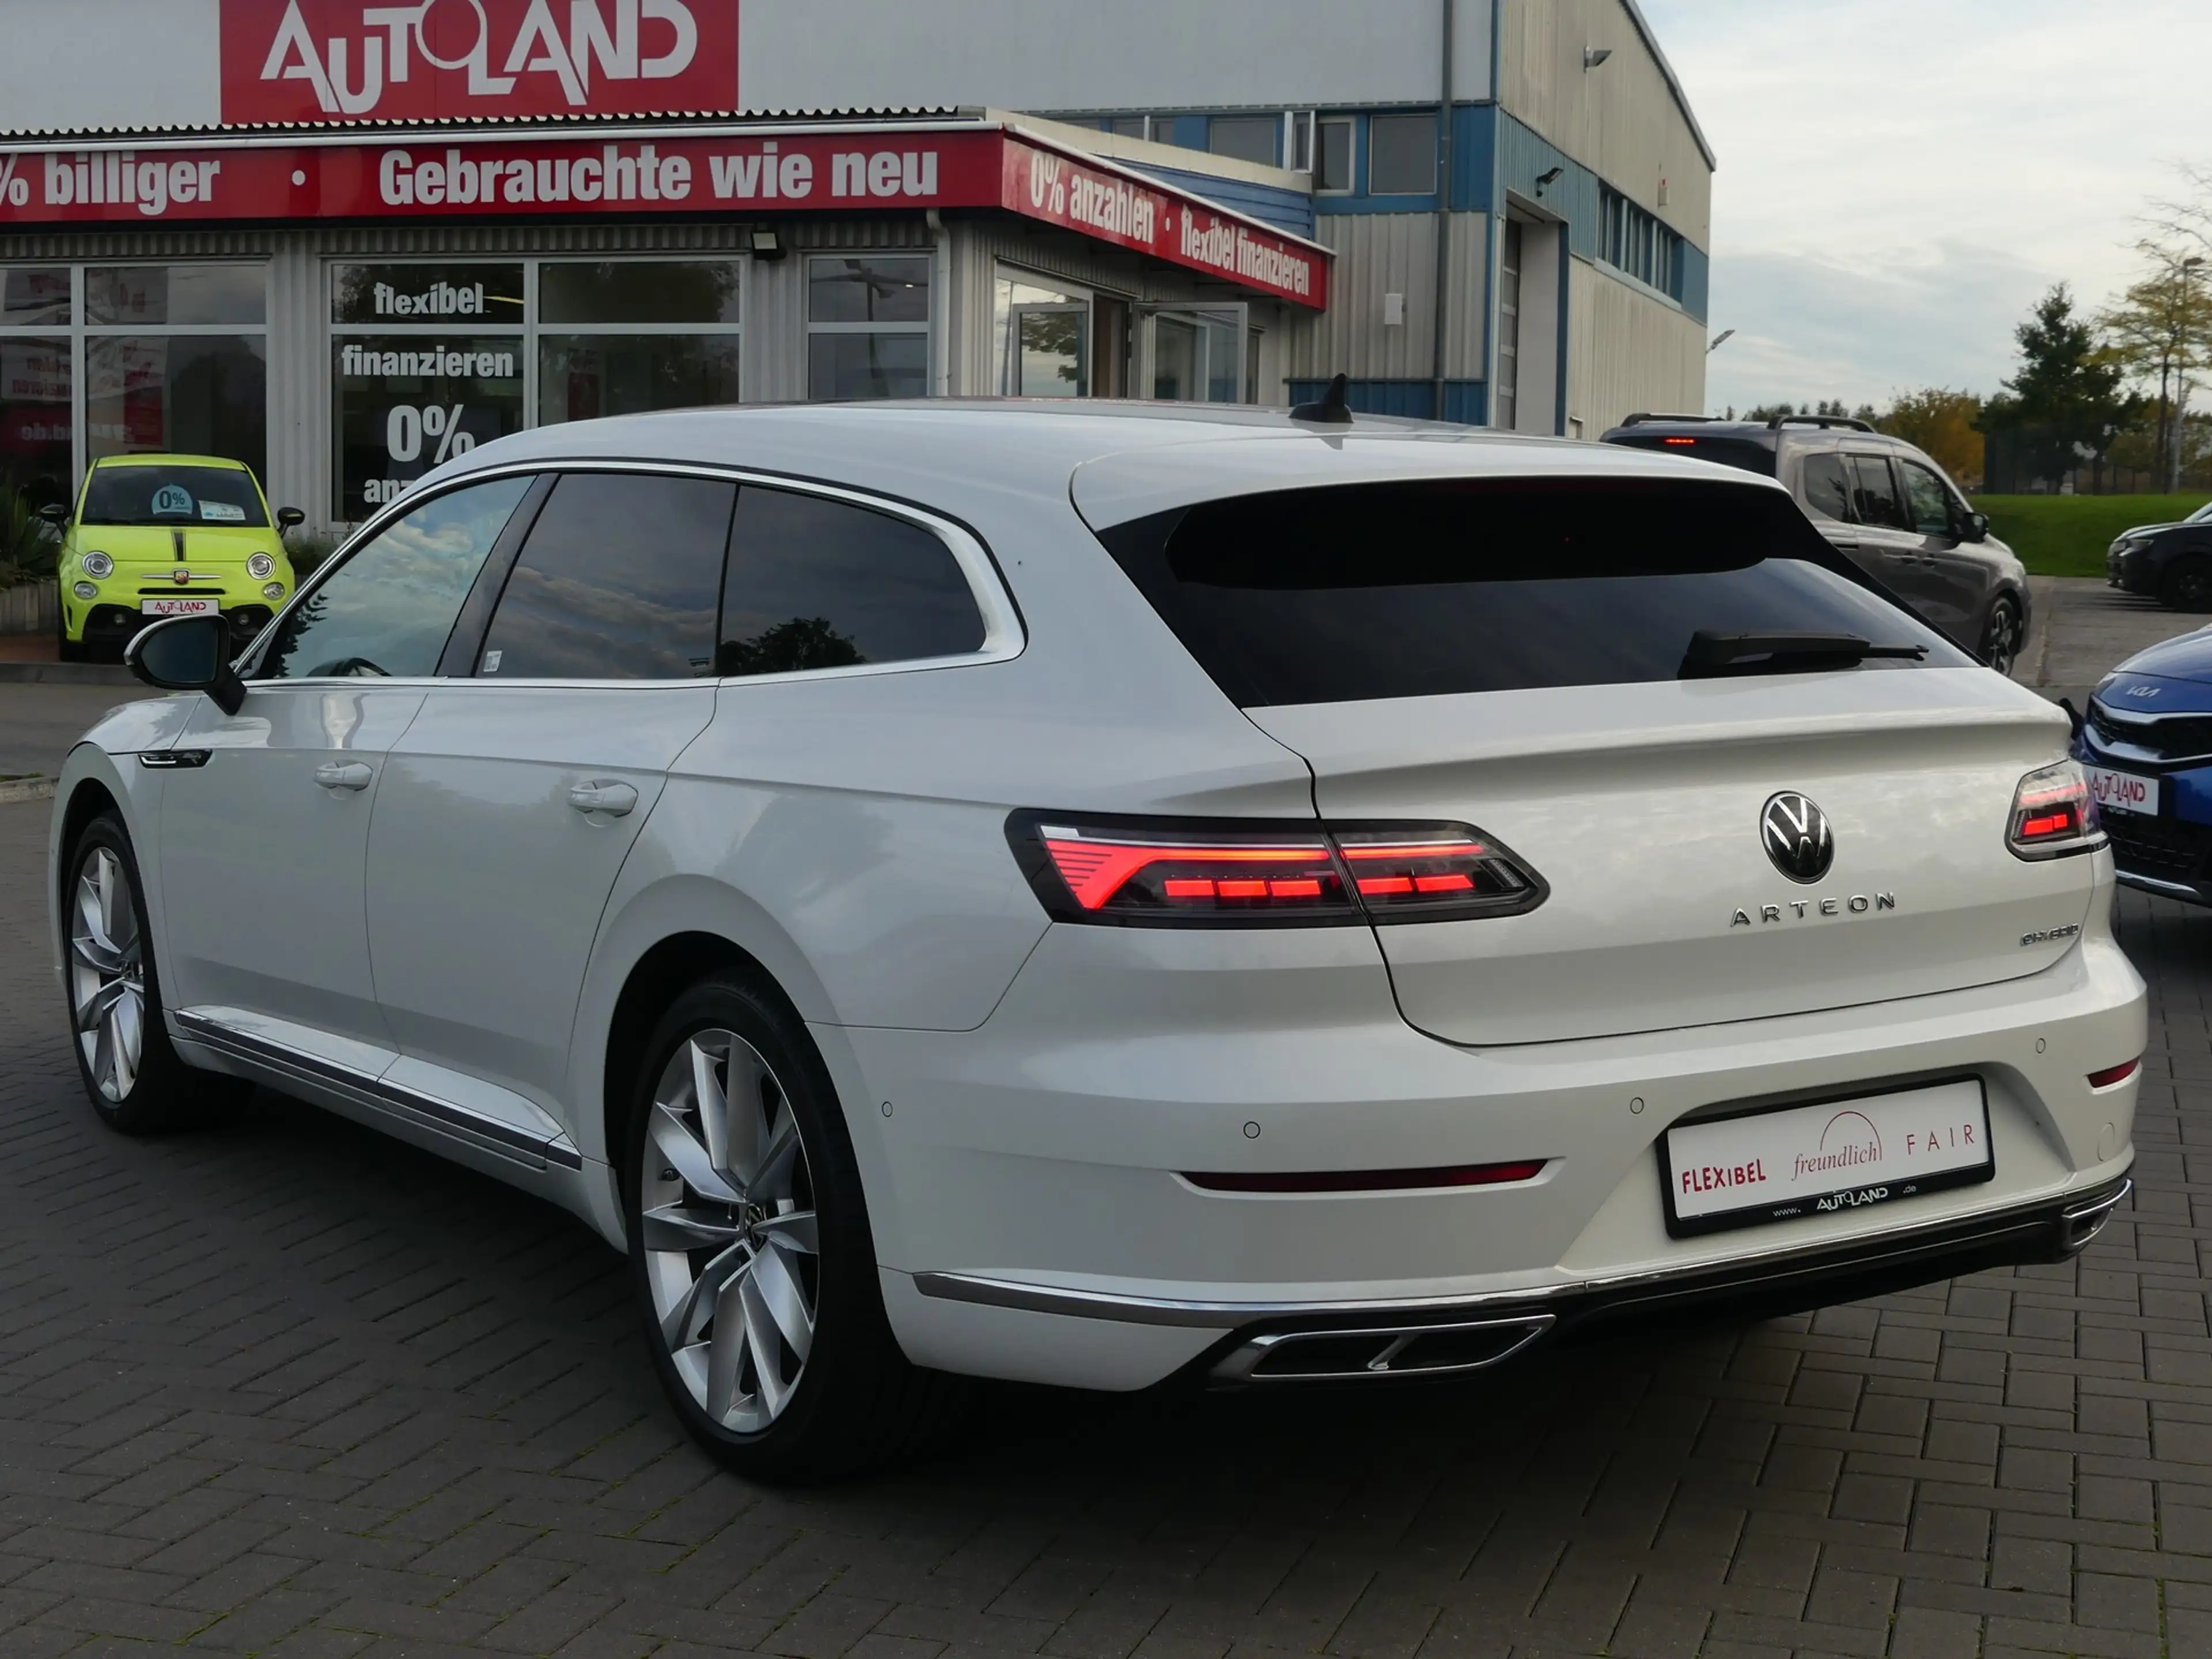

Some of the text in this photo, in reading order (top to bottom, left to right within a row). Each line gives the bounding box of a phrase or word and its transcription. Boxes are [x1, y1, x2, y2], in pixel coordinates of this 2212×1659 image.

[260, 0, 698, 113] AUTOLAND
[44, 151, 220, 215] billiger
[380, 142, 938, 206] Gebrauchte wie neu
[1030, 149, 1154, 244] 0% anzahlen
[1181, 203, 1309, 296] flexibel finanzieren
[374, 281, 483, 315] flexibel
[342, 344, 513, 377] finanzieren
[387, 404, 475, 464] 0%
[159, 491, 185, 510] 0%
[154, 600, 207, 613] AUTOLAND
[2093, 772, 2146, 807] AUTOLAND
[1730, 891, 1896, 927] ARTEON
[1682, 1124, 1975, 1194] FLEXIBEL freundlich FAIR
[1816, 1187, 1888, 1211] AUTOLAND
